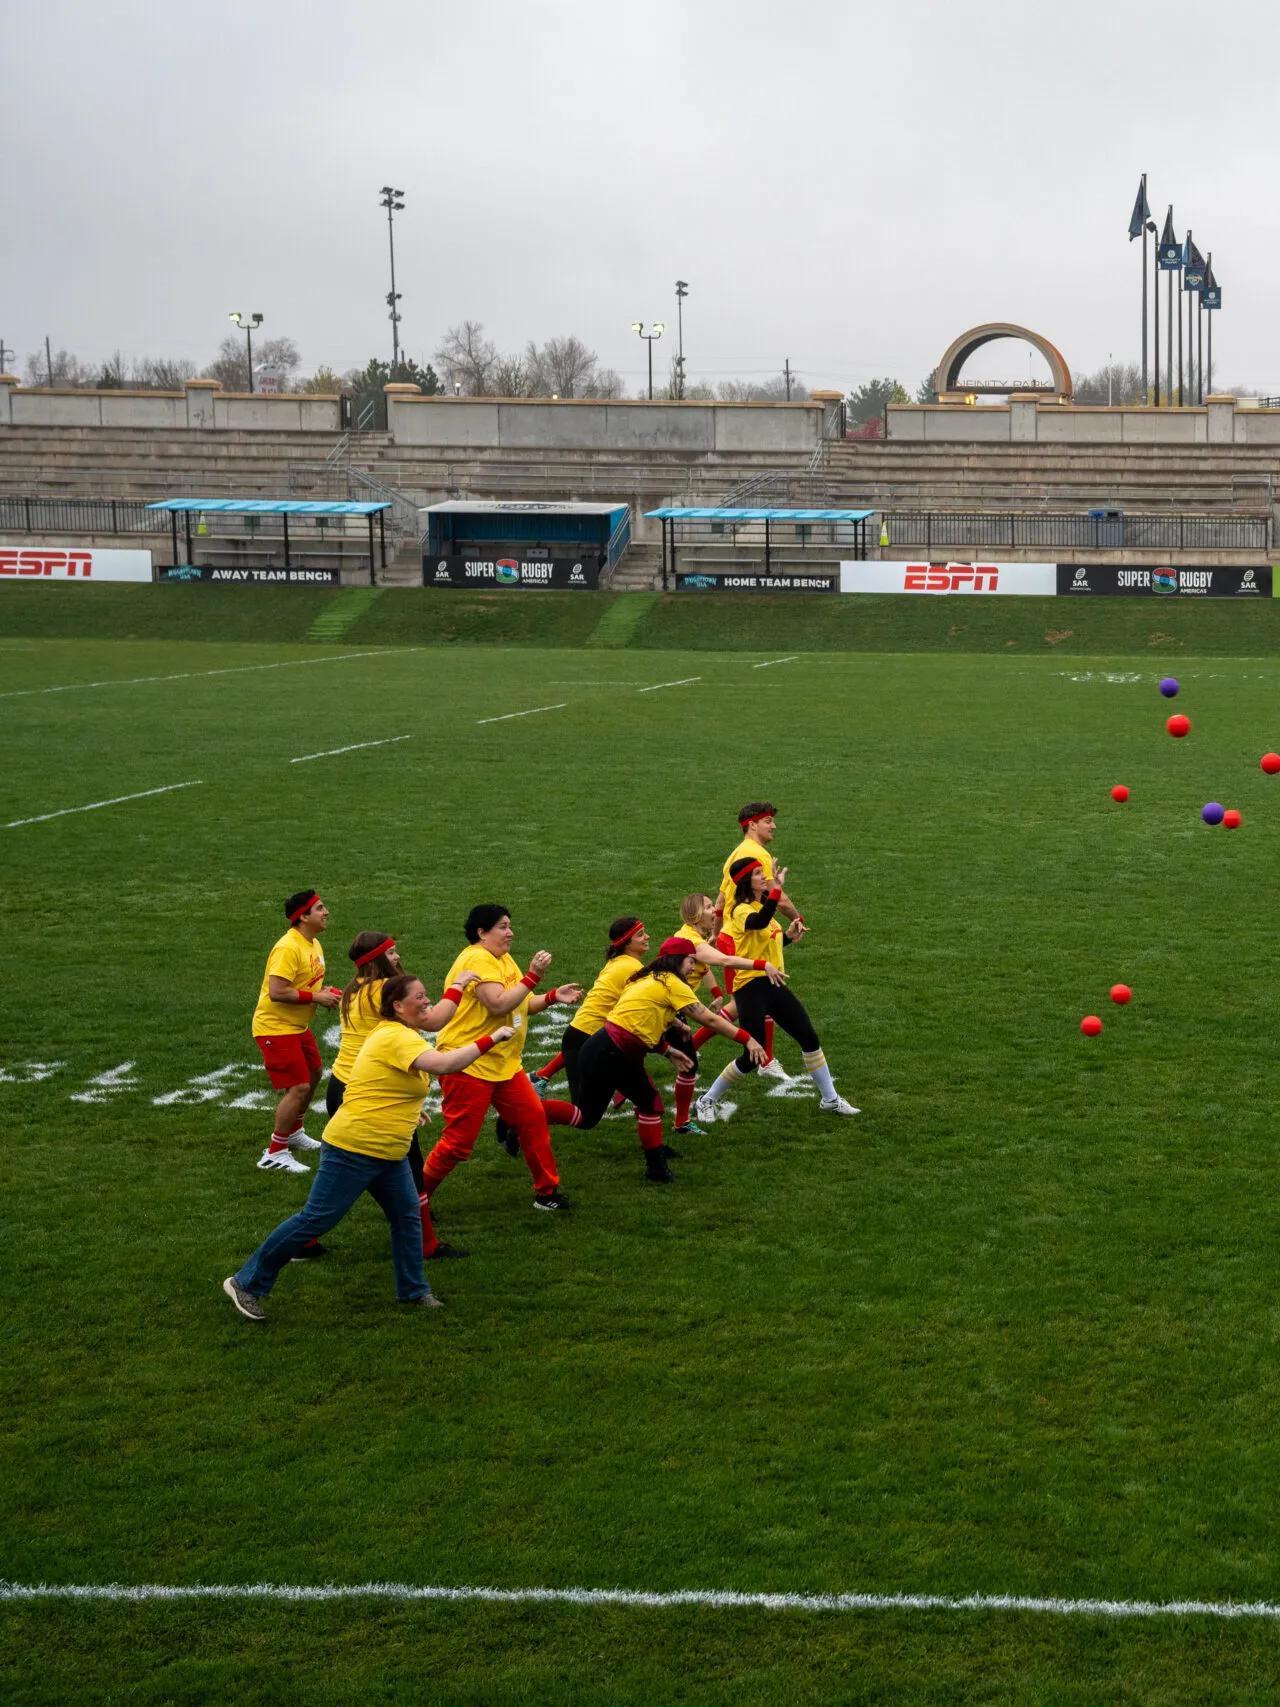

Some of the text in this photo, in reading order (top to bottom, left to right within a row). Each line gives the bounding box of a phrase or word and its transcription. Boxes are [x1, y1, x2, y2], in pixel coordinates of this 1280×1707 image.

[0, 551, 92, 576] ESPN
[465, 562, 554, 578] SUPER RUGBY
[212, 570, 248, 580] AWAY
[252, 571, 286, 580] TEAM
[290, 571, 332, 581] BENCH
[724, 578, 830, 588] HOME TEAM BENCH
[904, 566, 999, 590] ESPN
[1118, 571, 1213, 587] SUPER RUGBY
